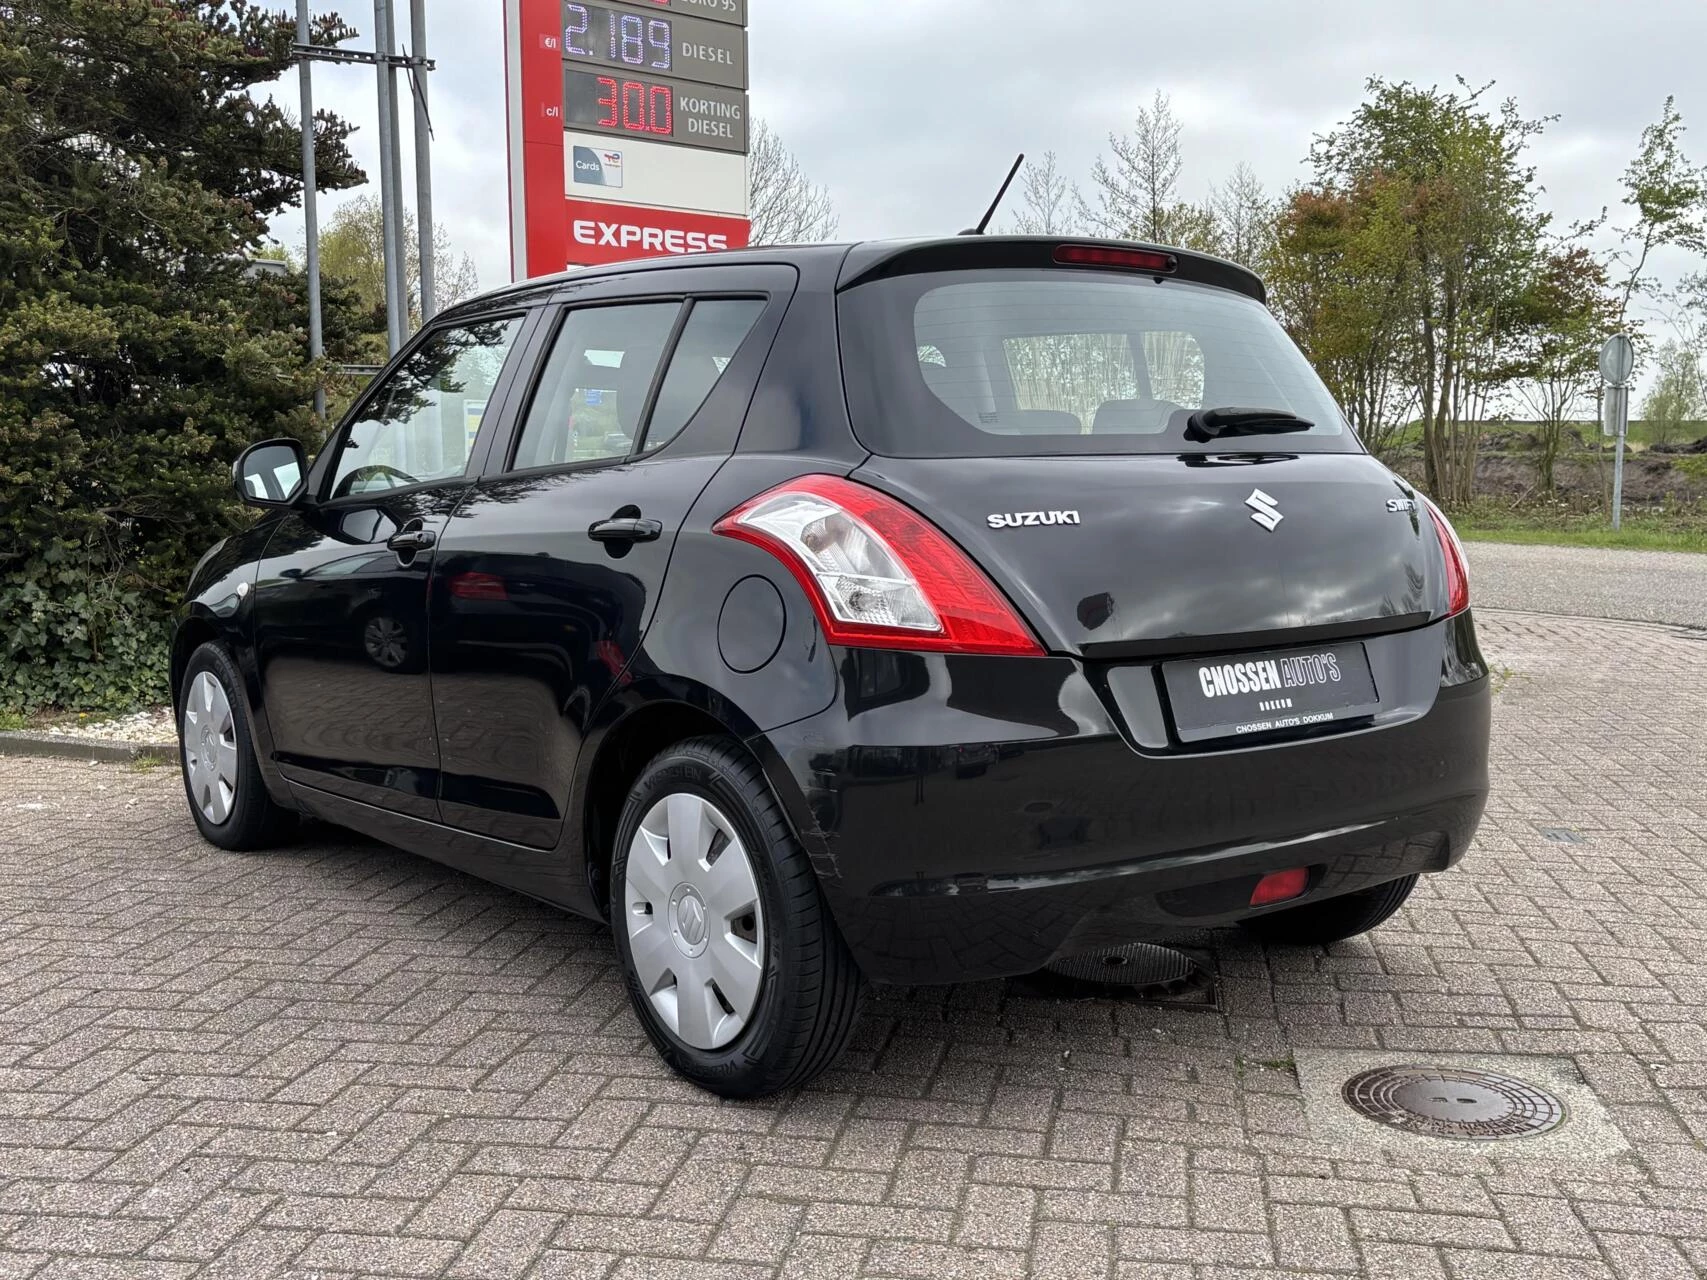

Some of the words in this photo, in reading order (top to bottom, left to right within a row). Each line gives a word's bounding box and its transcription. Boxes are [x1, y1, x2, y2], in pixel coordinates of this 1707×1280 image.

[722, 0, 737, 12] 95
[565, 5, 671, 69] 2.189
[682, 42, 734, 65] DIESEL
[680, 96, 742, 120] KORTING
[688, 118, 734, 139] DIESEL
[576, 160, 600, 171] Cards
[573, 219, 728, 254] EXPRESS
[987, 510, 1081, 530] SUZUKI
[1199, 659, 1282, 698] CNOSSEN
[1280, 652, 1342, 688] AUTO'S
[1236, 721, 1272, 734] CNOSSEN
[1275, 717, 1301, 729] AUTO'S
[1303, 712, 1334, 724] DOKKUM
